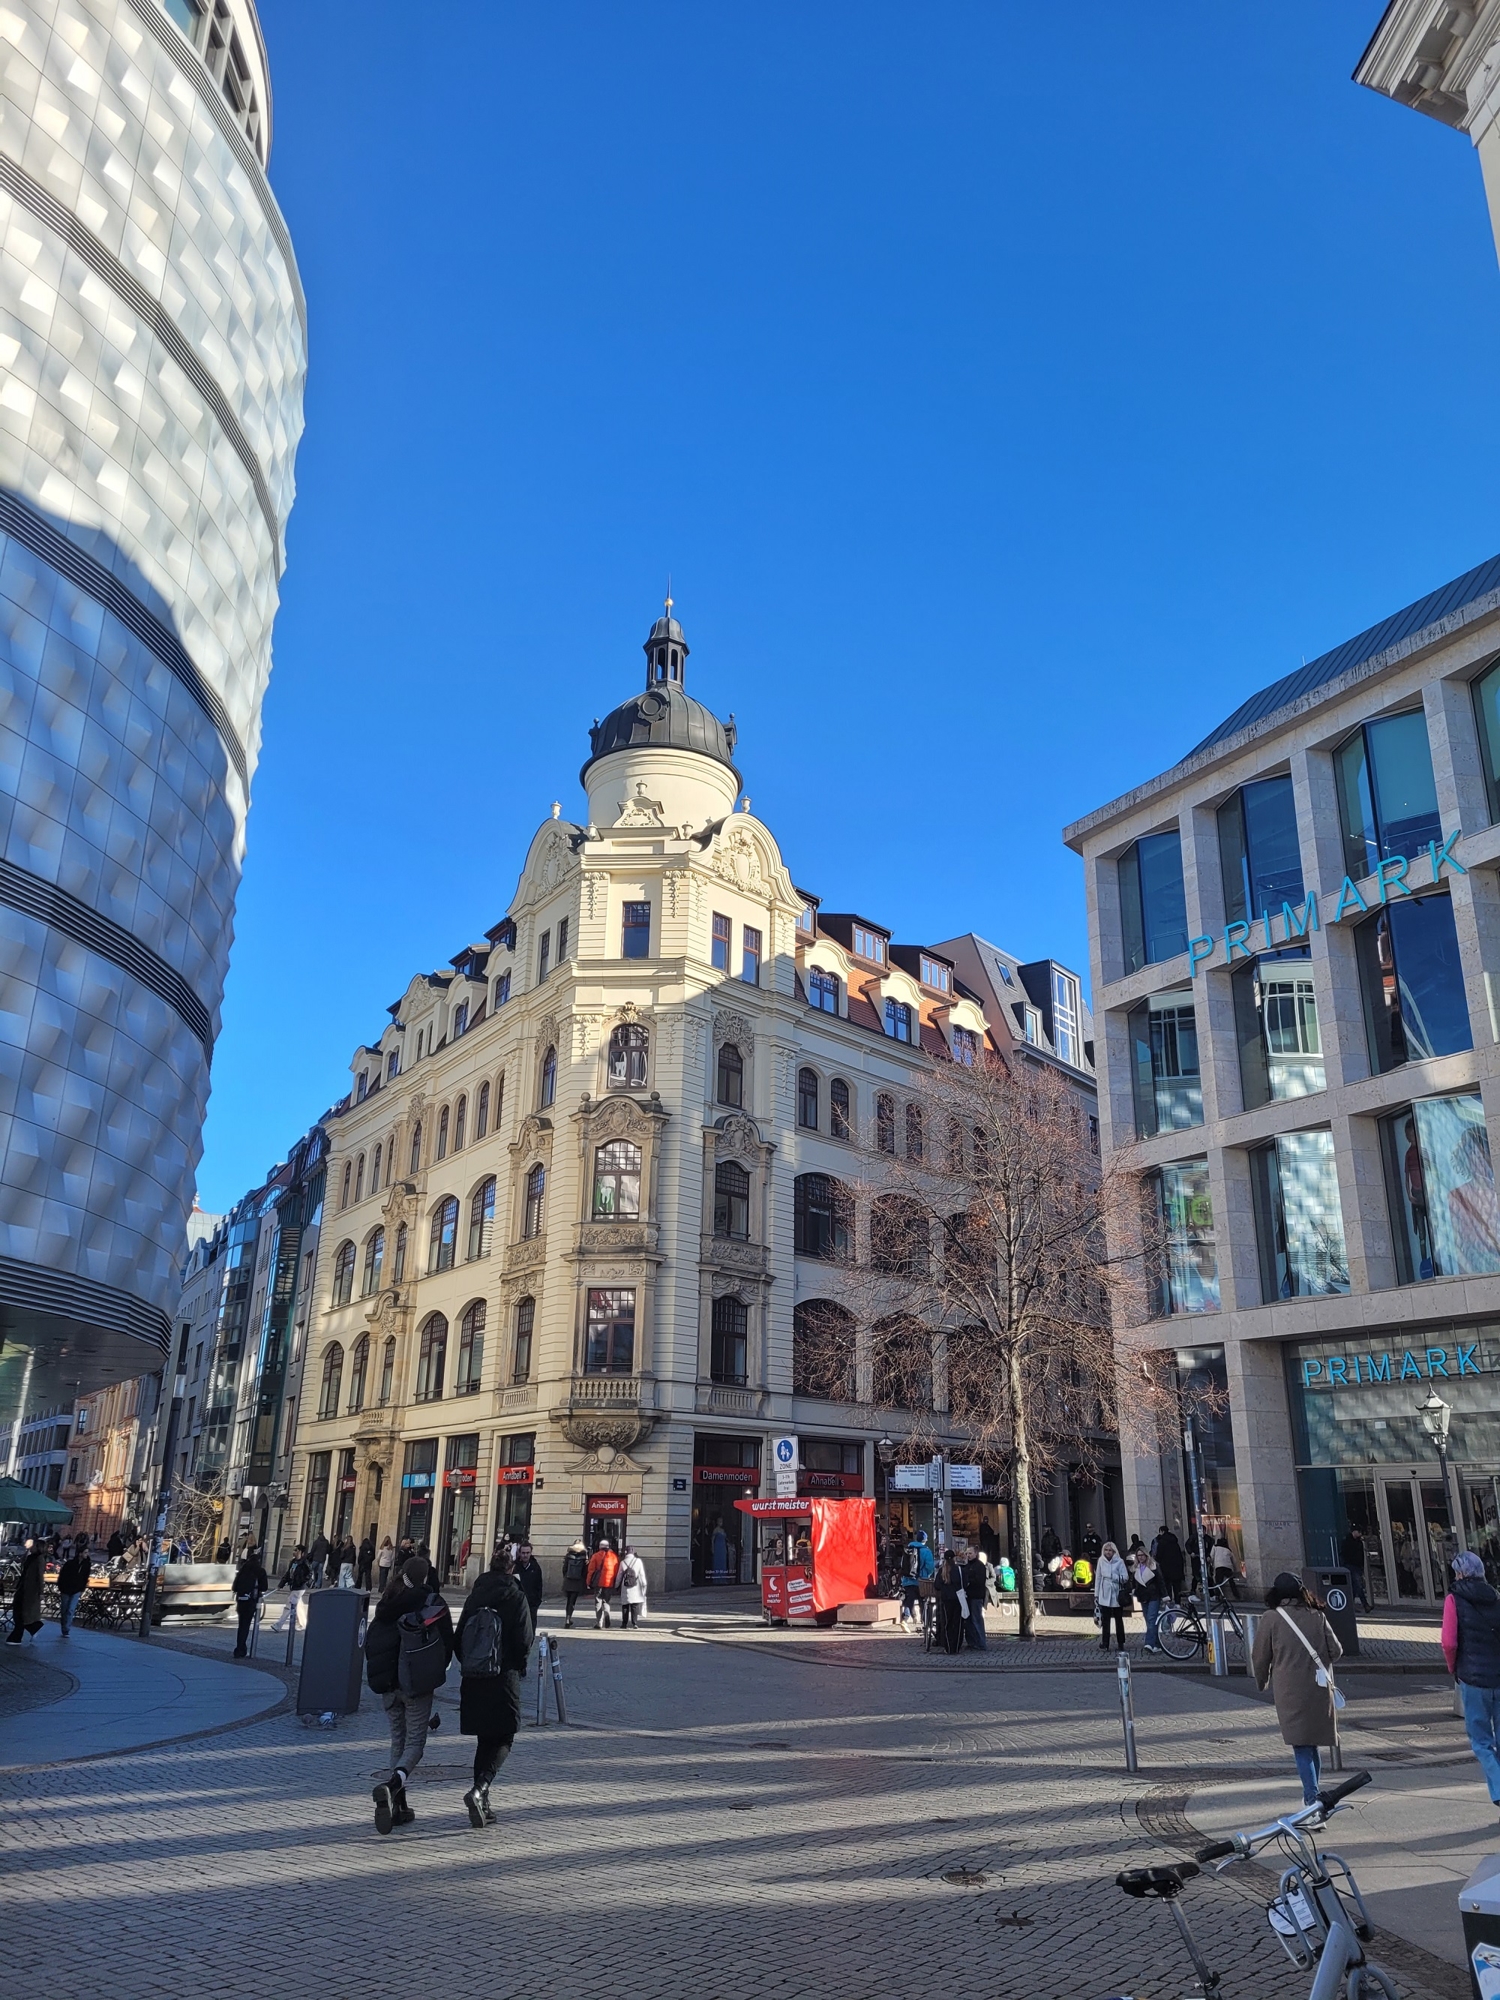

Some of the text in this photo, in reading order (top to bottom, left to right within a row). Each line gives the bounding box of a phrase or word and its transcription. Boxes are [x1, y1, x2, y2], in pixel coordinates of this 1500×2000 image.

[1188, 829, 1467, 978] PRIMARK
[1303, 1344, 1482, 1387] PRIMARK
[702, 1470, 753, 1482] Damenmoden
[752, 1500, 809, 1511] wurst meister
